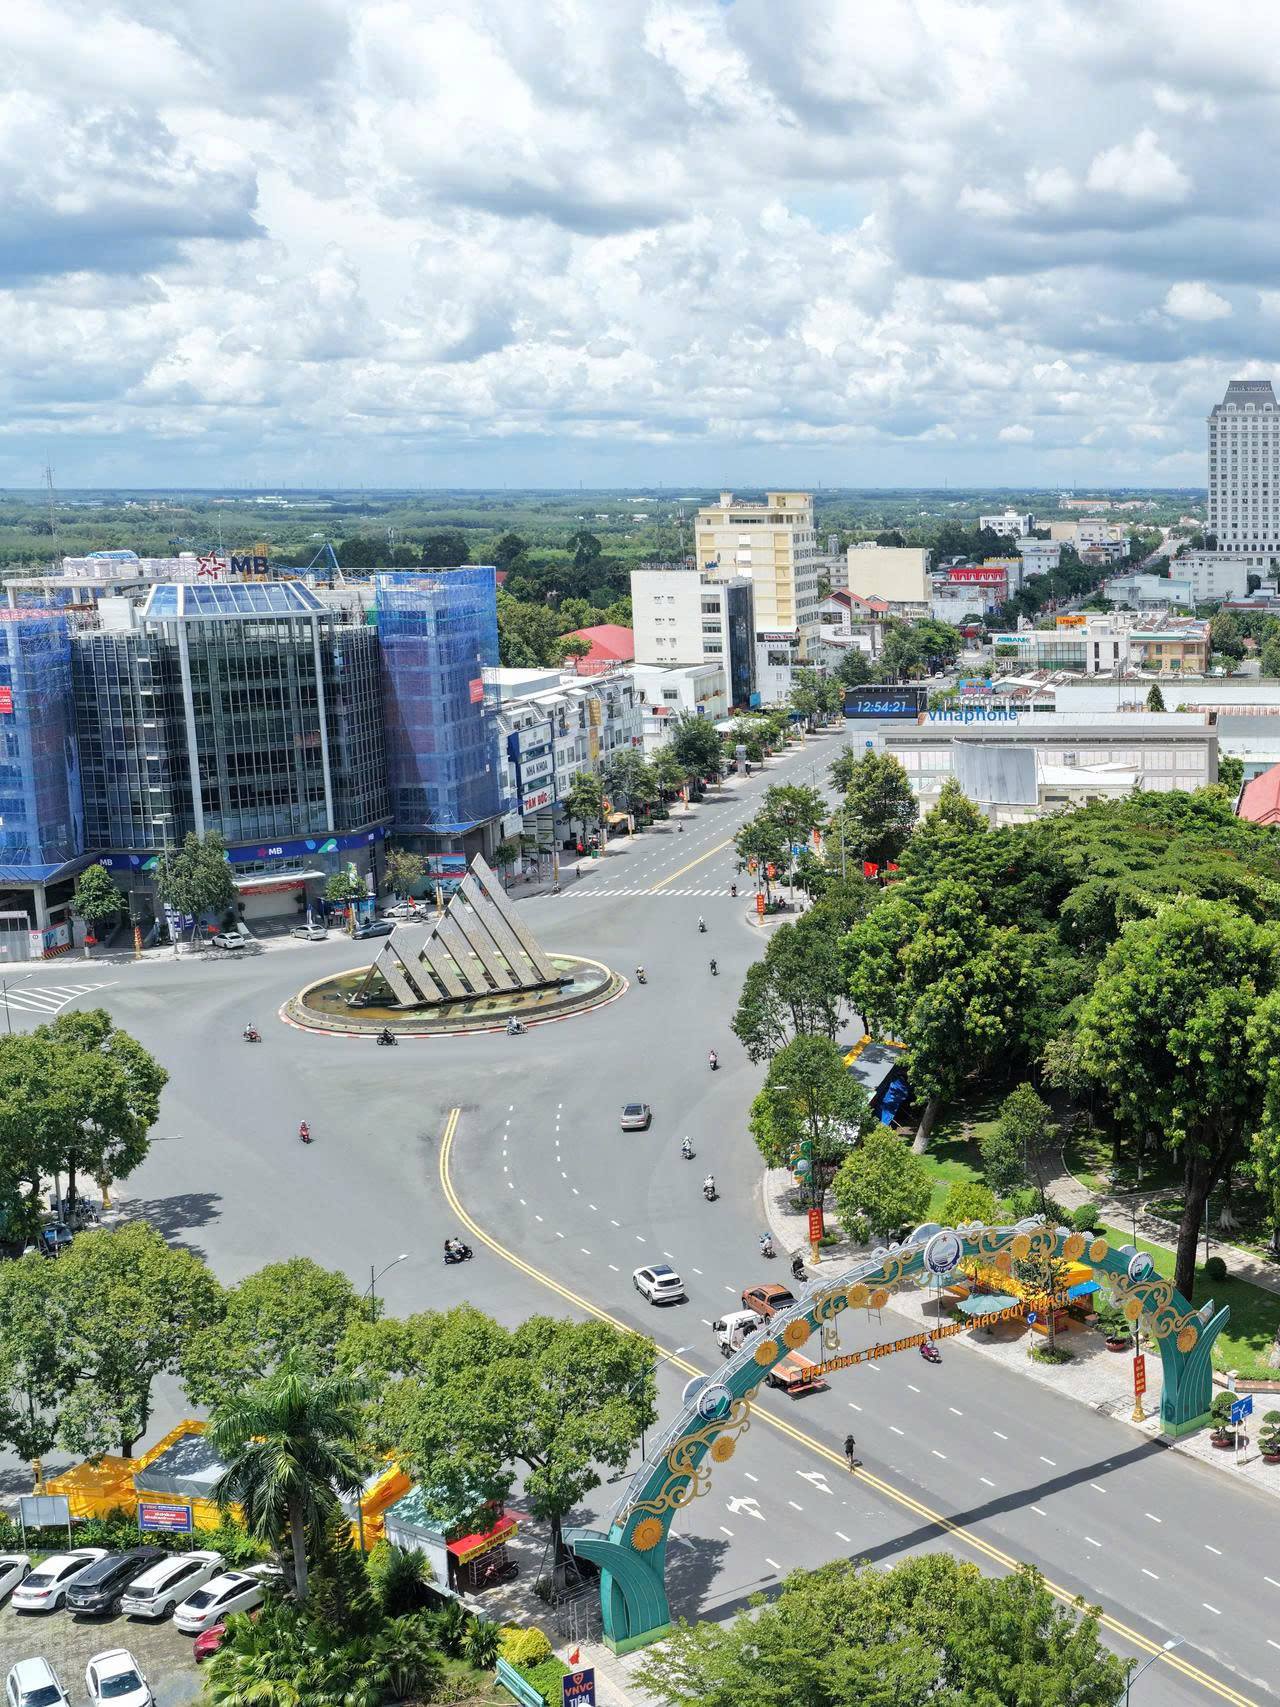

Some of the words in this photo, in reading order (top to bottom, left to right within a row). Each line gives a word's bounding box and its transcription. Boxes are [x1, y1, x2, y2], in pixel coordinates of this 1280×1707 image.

[231, 556, 269, 574] MB
[857, 701, 906, 712] 12:54:21
[928, 706, 1017, 724] vinaphone
[268, 847, 283, 856] MB
[100, 858, 113, 866] MB
[565, 1682, 593, 1697] VNVC
